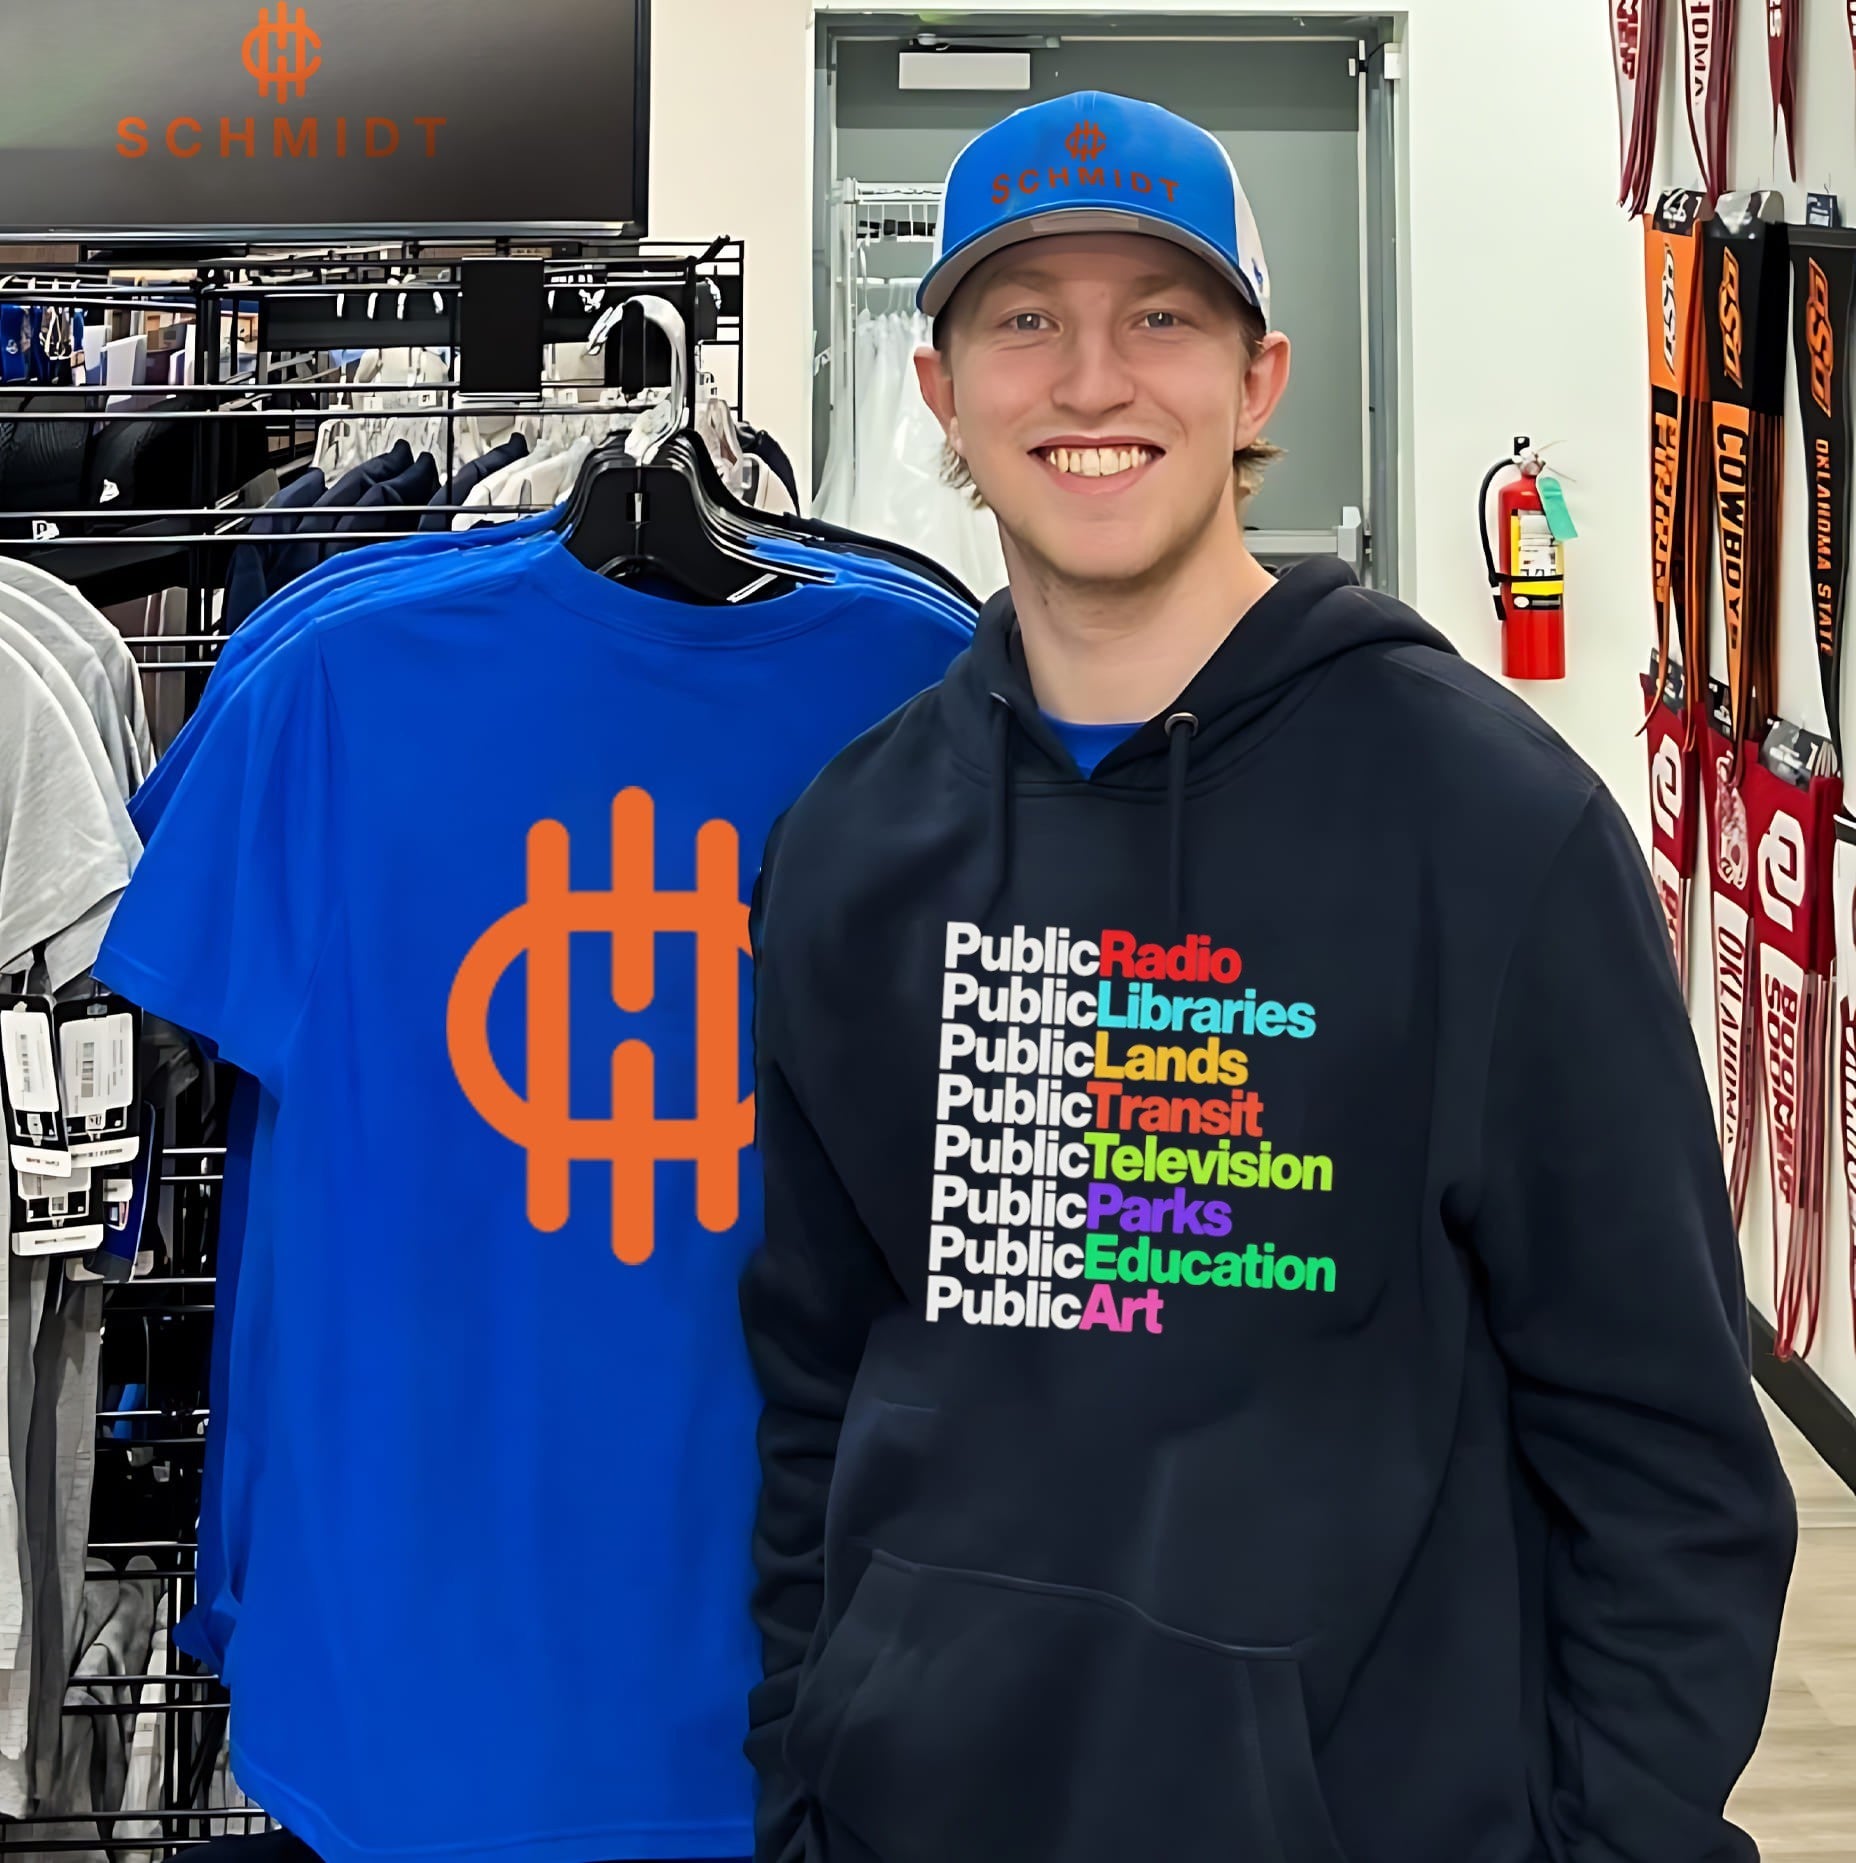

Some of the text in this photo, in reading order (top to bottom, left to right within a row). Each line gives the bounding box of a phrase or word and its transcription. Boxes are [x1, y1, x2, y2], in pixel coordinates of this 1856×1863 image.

[115, 116, 447, 159] SCHMIDT
[991, 166, 1179, 204] SCHMIDT
[1815, 438, 1832, 570] OKLAHOMA
